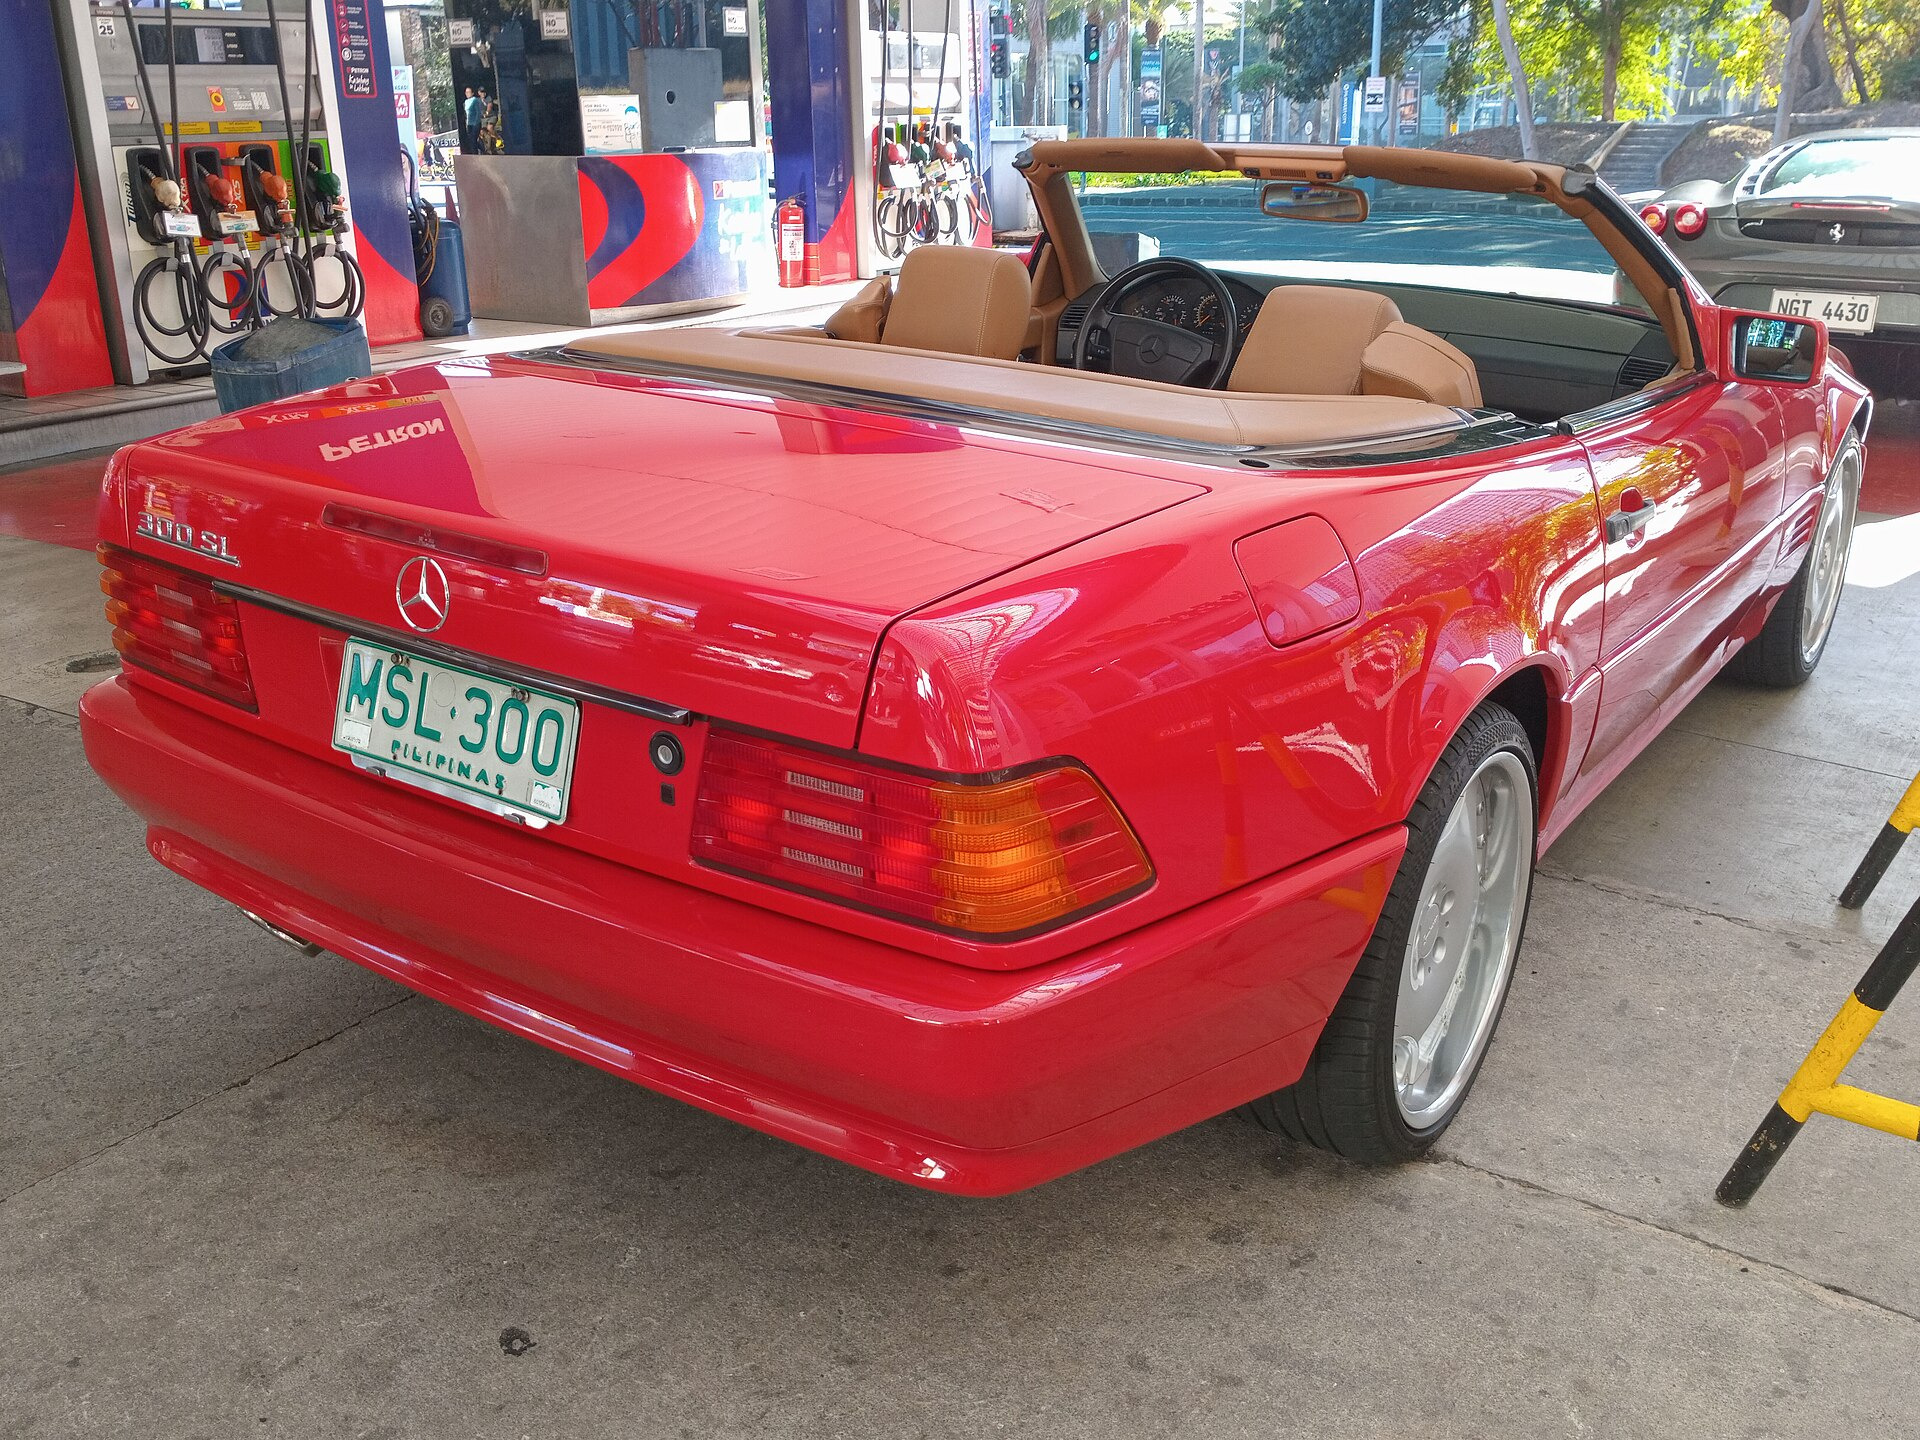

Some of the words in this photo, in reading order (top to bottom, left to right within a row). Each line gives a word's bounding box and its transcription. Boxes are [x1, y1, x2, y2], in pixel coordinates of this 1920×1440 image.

[99, 25, 114, 35] 25
[545, 19, 556, 27] NO
[452, 28, 462, 36] NO
[1777, 298, 1812, 317] NGT
[1822, 301, 1869, 322] 4430
[136, 511, 193, 548] 300
[200, 530, 238, 560] SL
[391, 739, 507, 790] PILIPINAS
